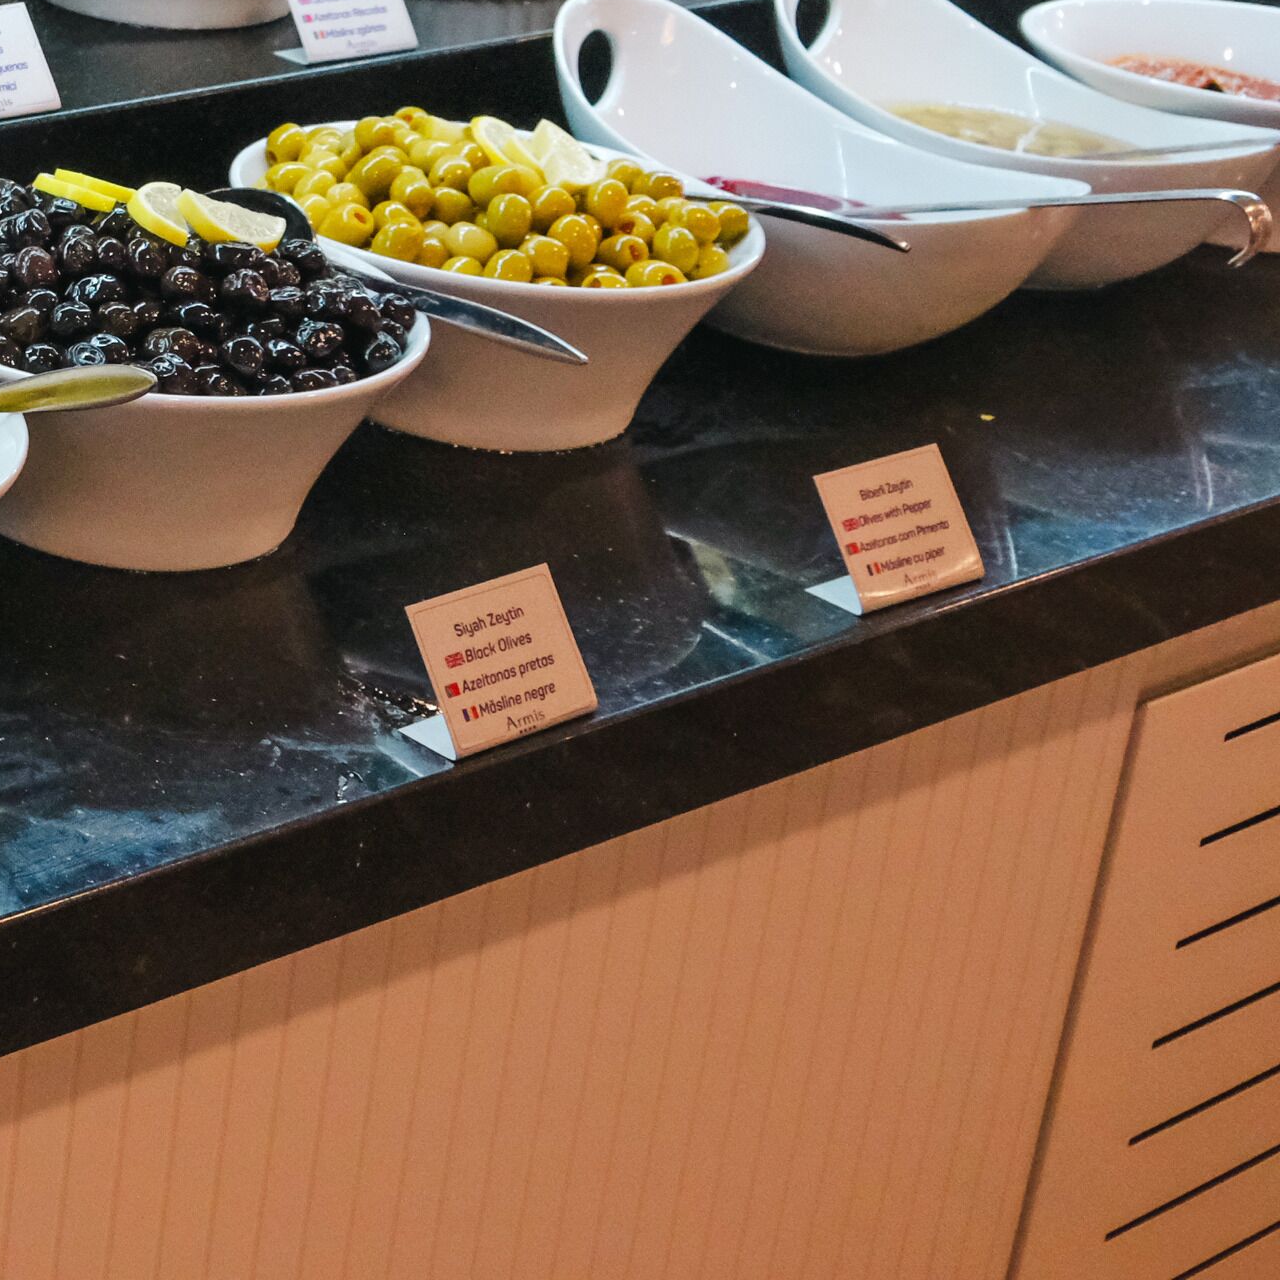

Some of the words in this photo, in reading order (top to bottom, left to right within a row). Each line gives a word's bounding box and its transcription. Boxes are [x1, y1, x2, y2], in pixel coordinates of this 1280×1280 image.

[886, 478, 913, 496] Zeytin
[858, 512, 884, 527] Olives
[884, 506, 902, 519] with
[902, 498, 932, 517] Pepper
[859, 532, 898, 553] Azeitonas
[898, 529, 916, 542] com
[913, 551, 925, 563] cu
[925, 545, 945, 562] piper
[453, 615, 487, 638] Siyah
[487, 605, 524, 627] Zeytin
[464, 642, 496, 663] Black
[497, 631, 533, 652] Olives
[462, 666, 517, 694] Azeitonas
[518, 652, 555, 678] pretas
[524, 681, 556, 703] negre
[506, 708, 546, 731] Armis
